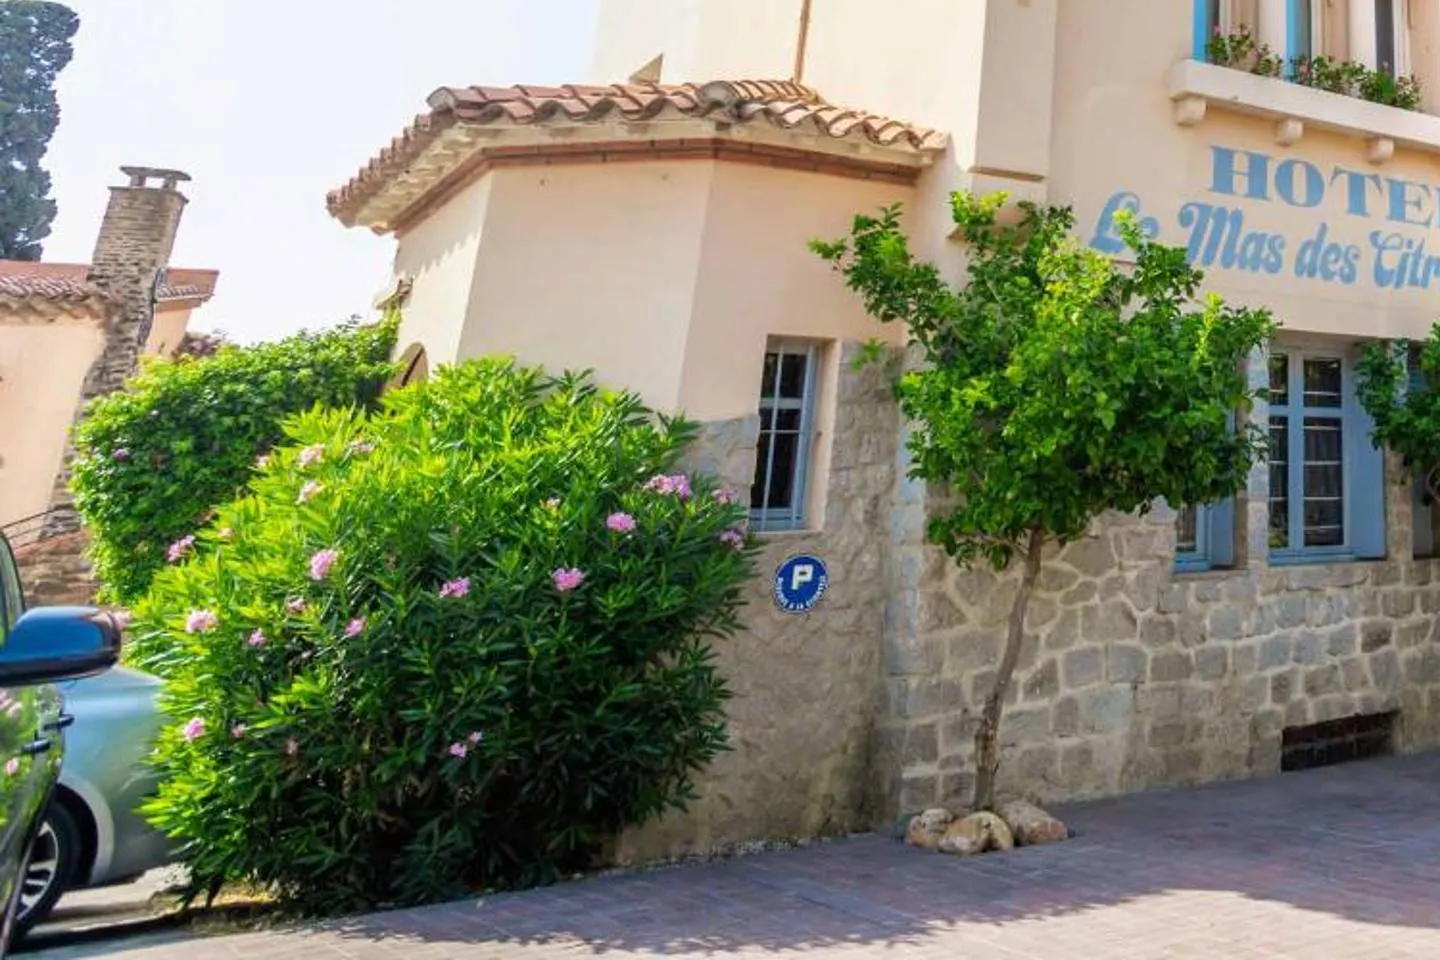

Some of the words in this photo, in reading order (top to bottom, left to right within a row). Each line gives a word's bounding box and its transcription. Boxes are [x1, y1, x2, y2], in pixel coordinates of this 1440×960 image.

[1178, 202, 1283, 276] Mas
[1293, 222, 1361, 284] des
[791, 564, 813, 590] P
